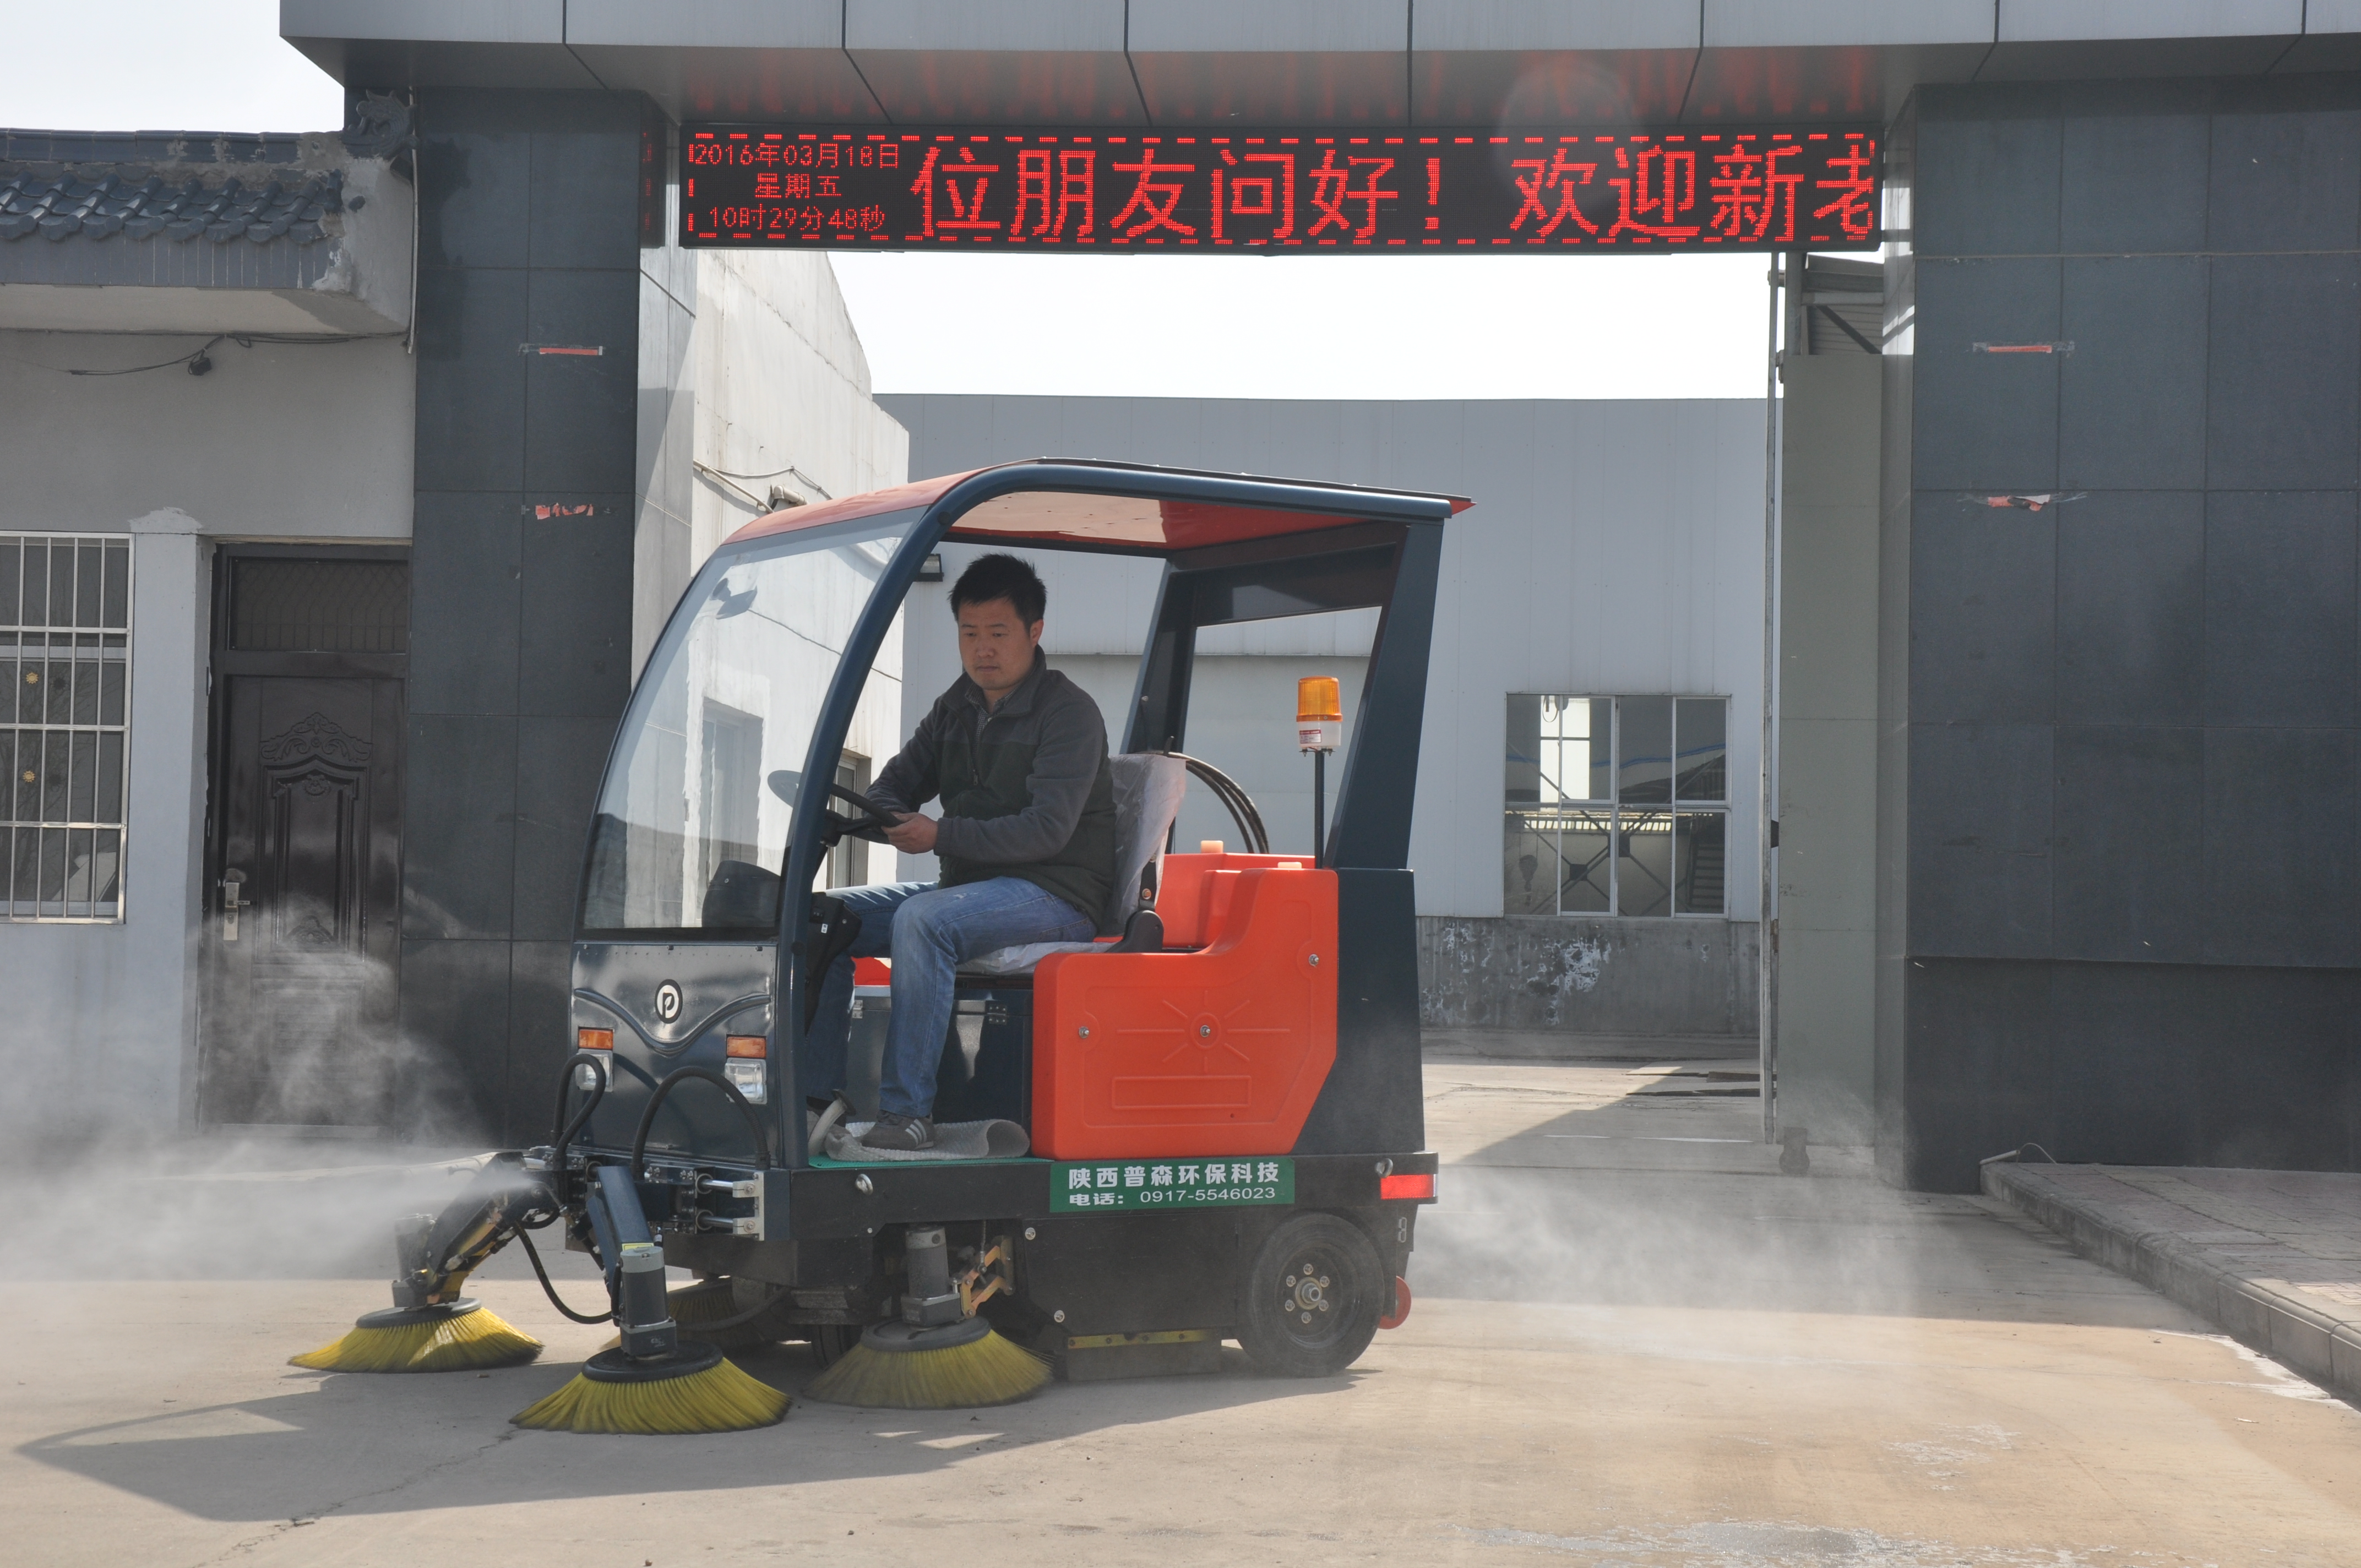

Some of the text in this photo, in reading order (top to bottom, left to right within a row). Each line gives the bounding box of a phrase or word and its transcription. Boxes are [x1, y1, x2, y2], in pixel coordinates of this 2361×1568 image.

[695, 143, 899, 168] 2016年03月18日
[755, 173, 842, 199] 星期五
[710, 204, 885, 231] 10时29分48秒
[1069, 1162, 1279, 1189] 陕西普森环保科技
[1140, 1187, 1276, 1203] 0917-5546023
